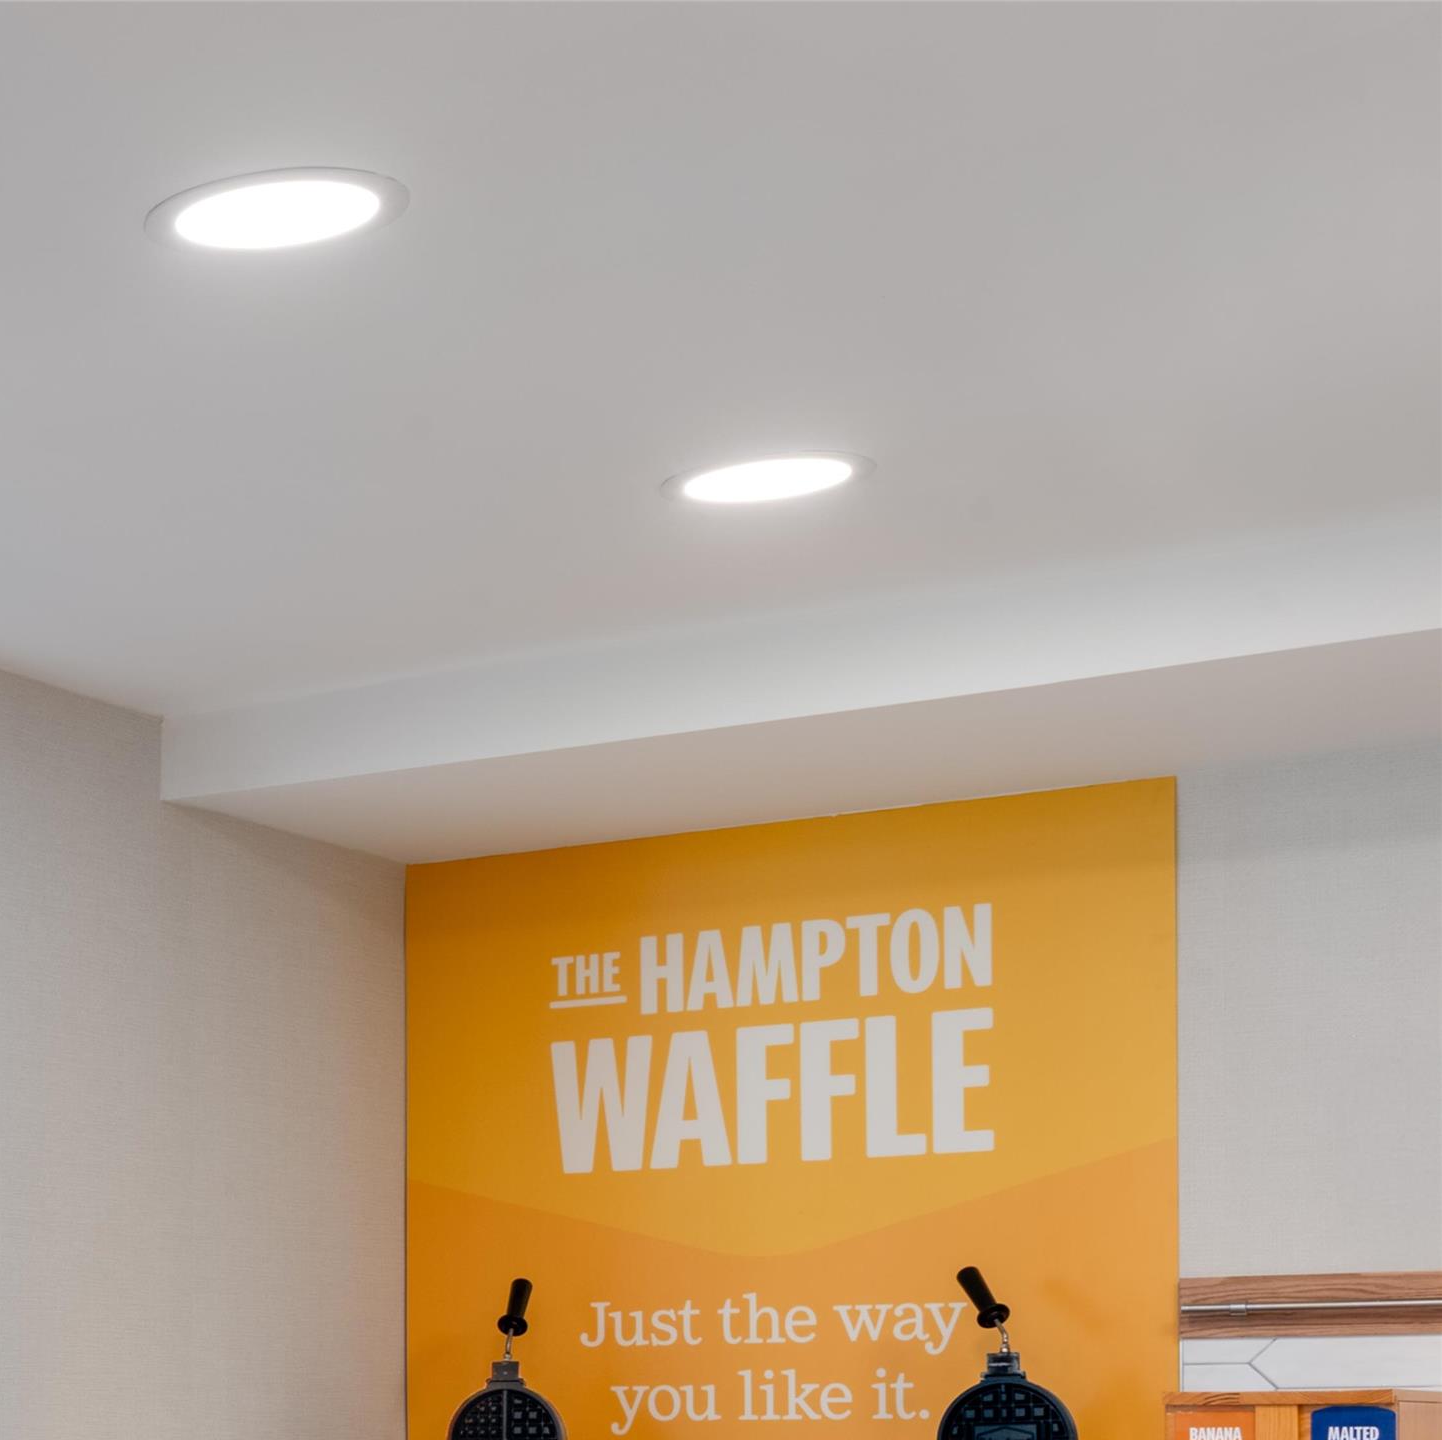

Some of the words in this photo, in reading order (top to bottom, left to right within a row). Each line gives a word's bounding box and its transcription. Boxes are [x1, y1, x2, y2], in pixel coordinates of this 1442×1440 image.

[551, 951, 621, 998] THE
[640, 902, 994, 1015] HAMPTON
[550, 1007, 995, 1174] WAFFLE
[579, 1298, 703, 1348] Just
[717, 1291, 818, 1344] the
[832, 1301, 968, 1355] way
[610, 1382, 723, 1436] you
[737, 1368, 854, 1422] like
[870, 1366, 932, 1421] it.
[1328, 1426, 1379, 1440] MALTED
